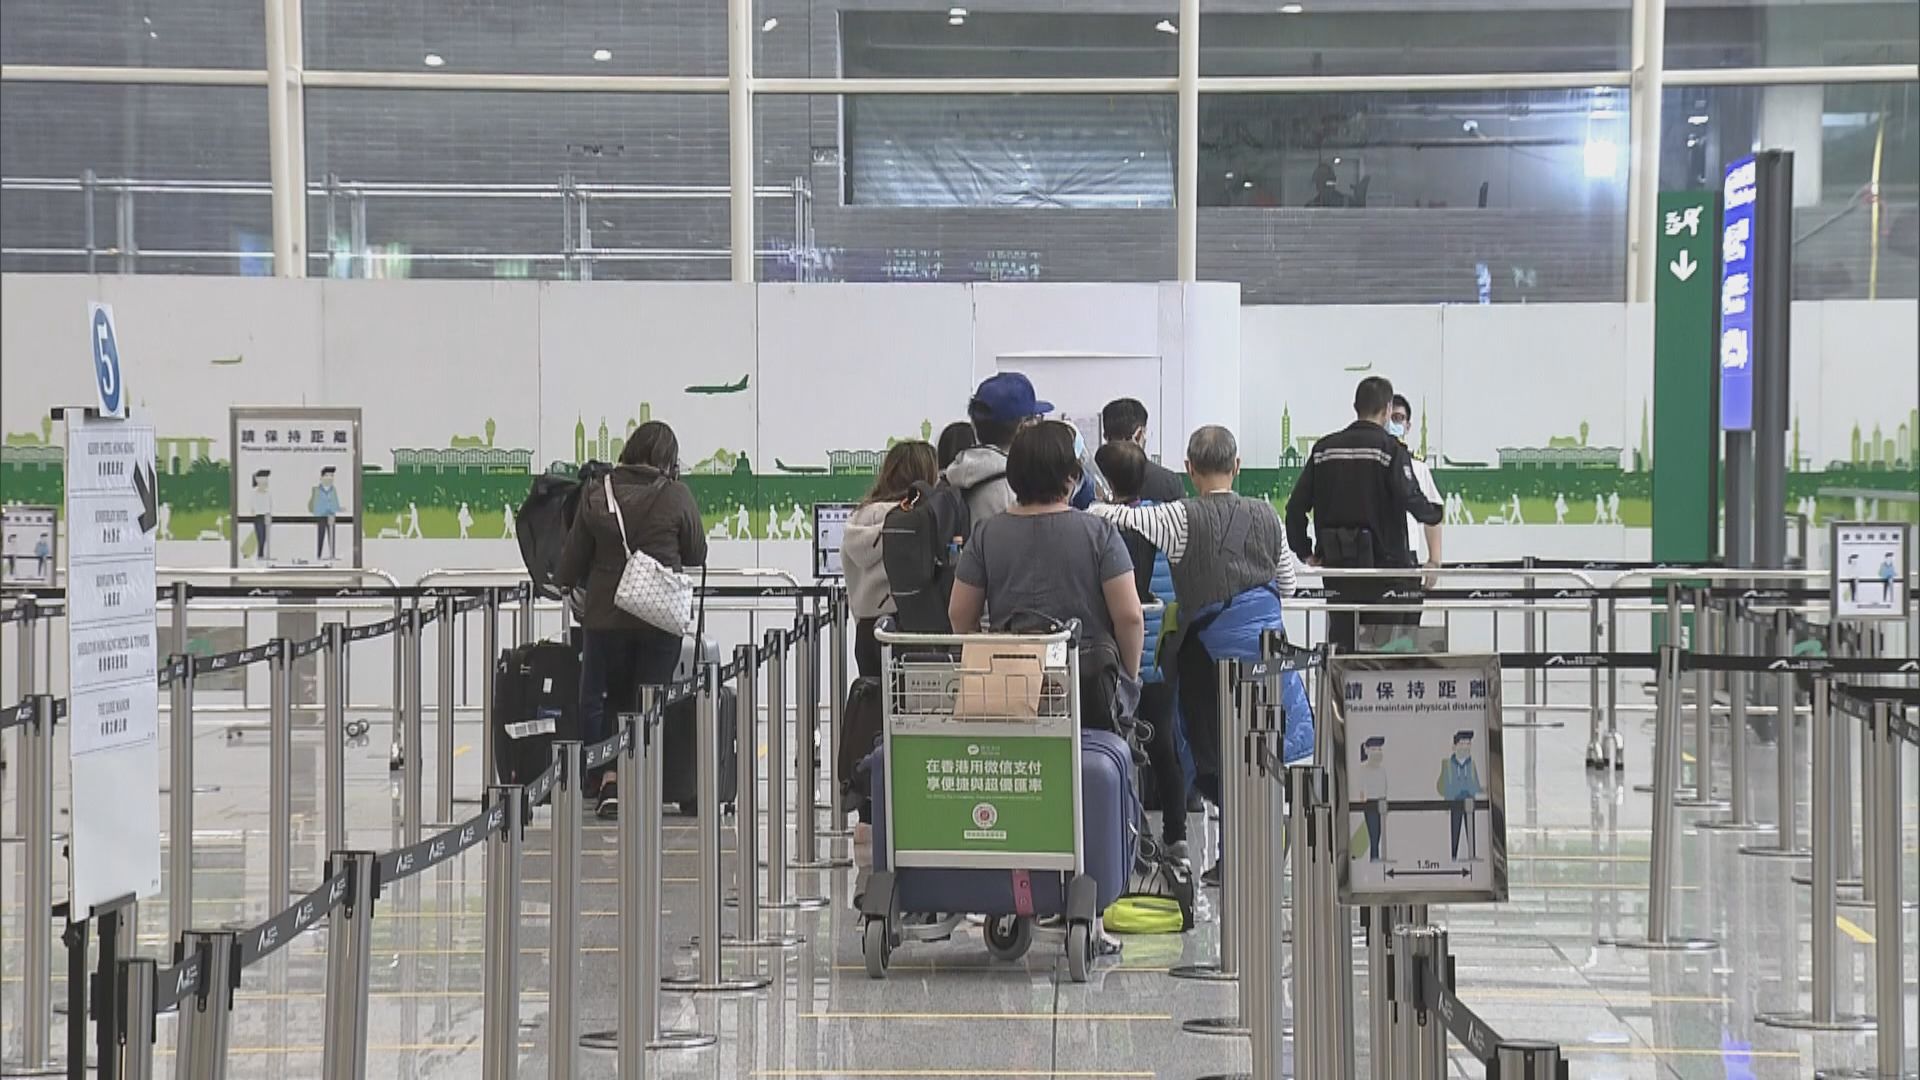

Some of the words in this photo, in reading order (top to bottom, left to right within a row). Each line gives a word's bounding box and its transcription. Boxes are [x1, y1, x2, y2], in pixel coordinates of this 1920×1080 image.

[97, 322, 114, 395] 5
[1375, 702, 1413, 712] maintain
[1415, 702, 1450, 713] physical
[926, 759, 1042, 775] 在香港用微信支付
[1417, 860, 1440, 869] 1.5m
